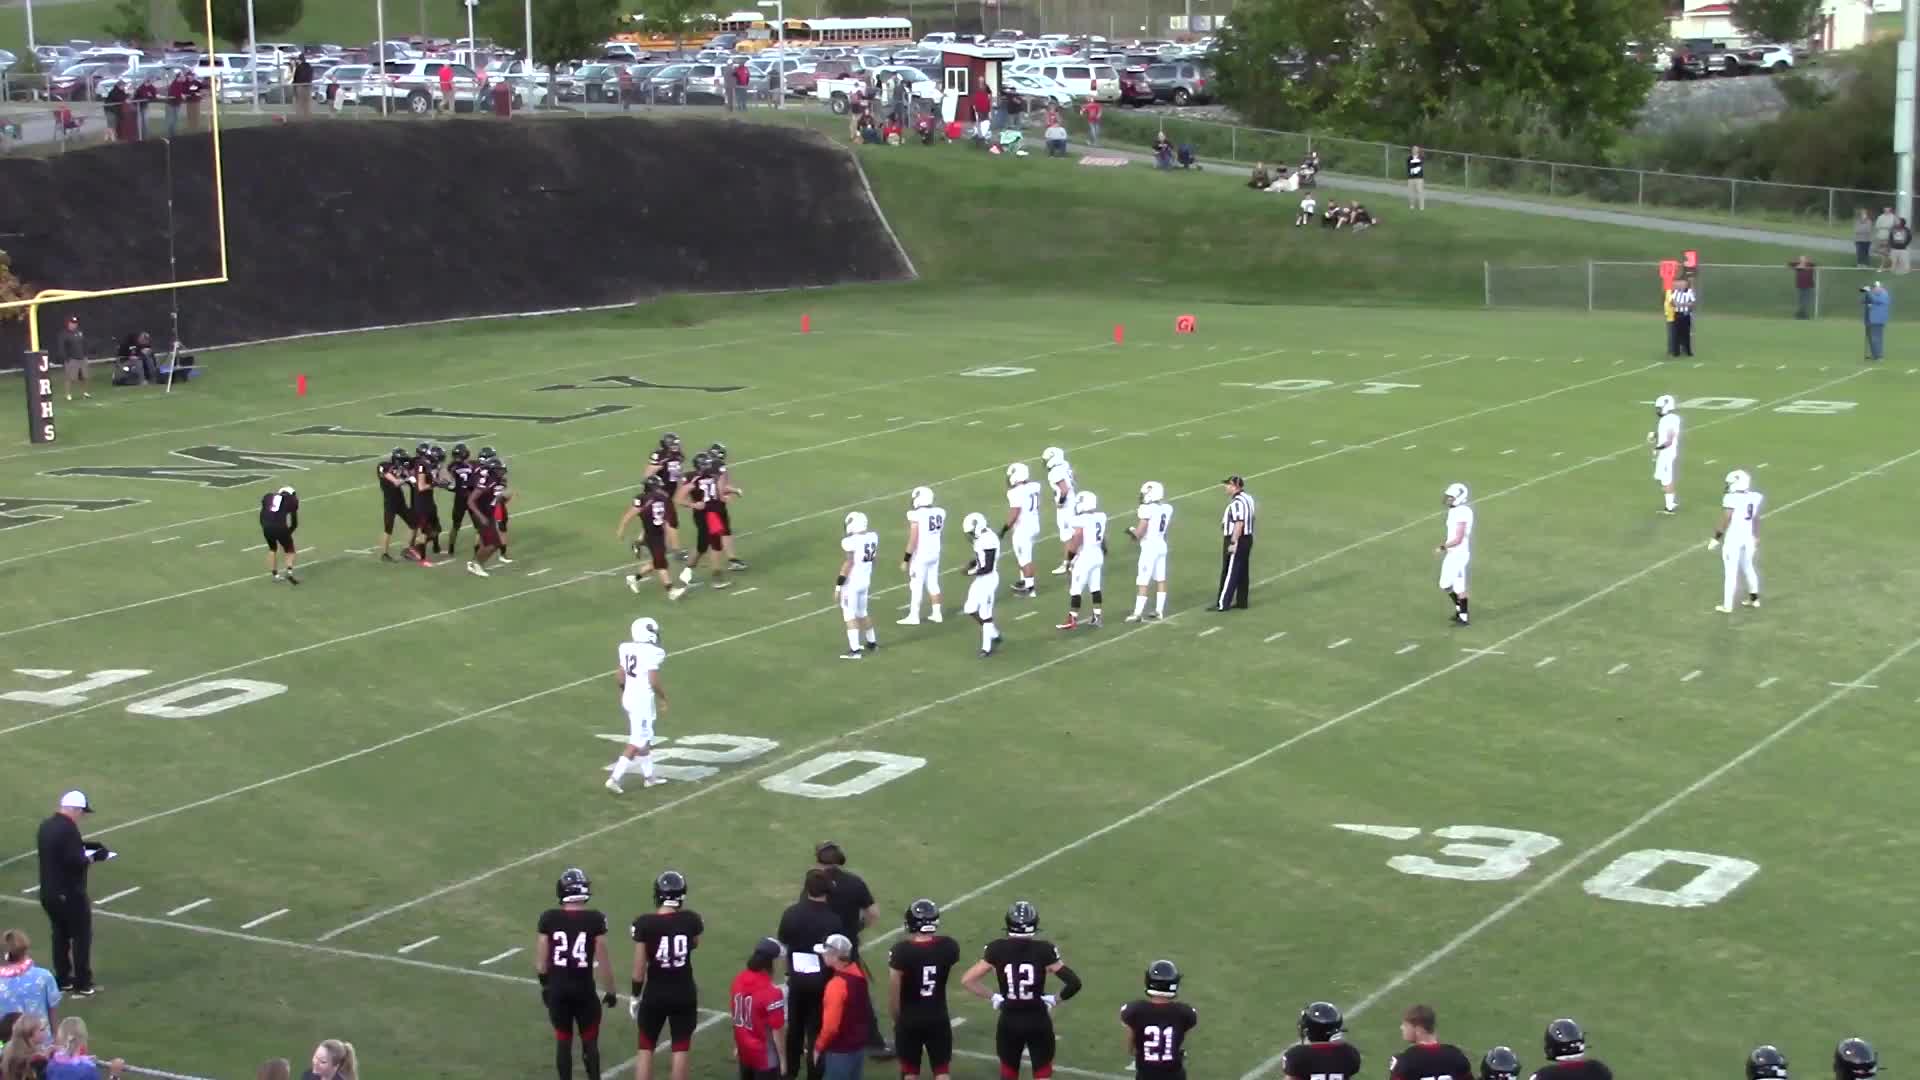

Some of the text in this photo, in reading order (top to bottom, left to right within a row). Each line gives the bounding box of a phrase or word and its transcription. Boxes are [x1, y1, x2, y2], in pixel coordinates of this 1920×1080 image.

[40, 355, 55, 441] JRHS
[625, 654, 637, 677] 12
[553, 932, 588, 967] 24
[655, 935, 687, 967] 49
[920, 965, 937, 997] 5
[1003, 963, 1035, 1000] 12
[734, 993, 753, 1030] 11
[1143, 1025, 1174, 1061] 21
